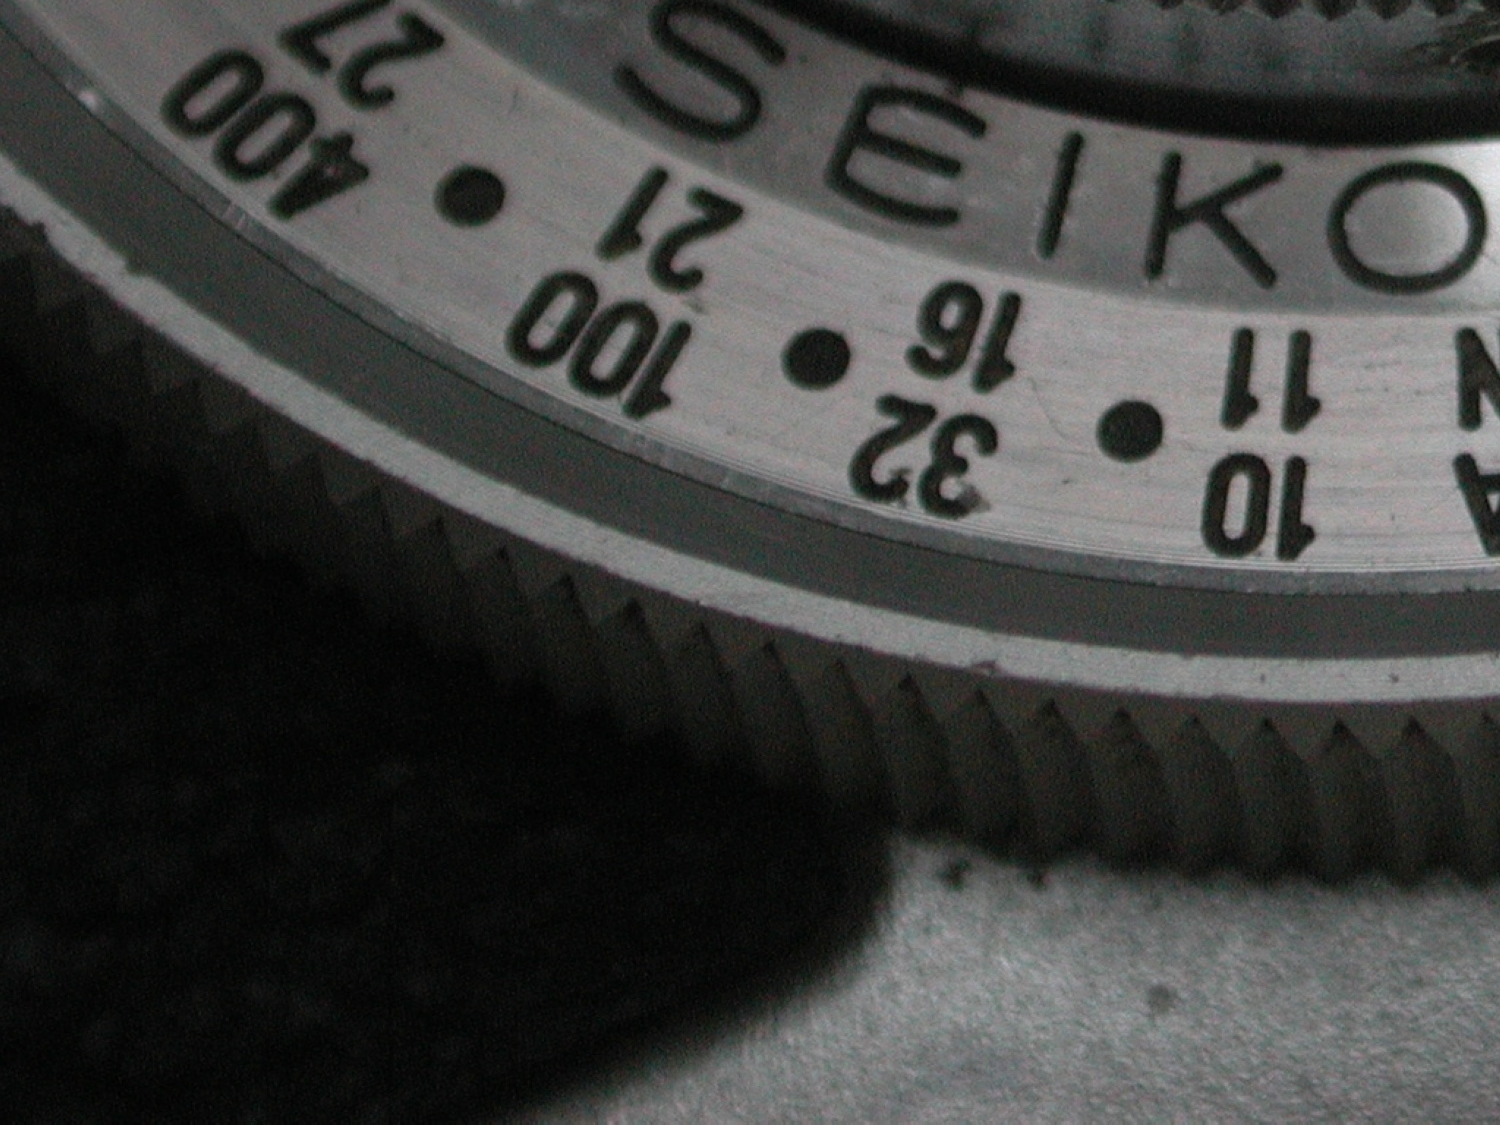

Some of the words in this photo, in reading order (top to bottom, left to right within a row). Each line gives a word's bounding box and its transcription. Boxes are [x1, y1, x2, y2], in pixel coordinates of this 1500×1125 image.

[160, 48, 371, 219] 400
[595, 165, 745, 294] 21
[504, 270, 695, 421] 100
[905, 280, 1025, 394] 16
[1220, 326, 1322, 433] 11
[846, 393, 1000, 519] 32
[1202, 451, 1317, 562] 10
